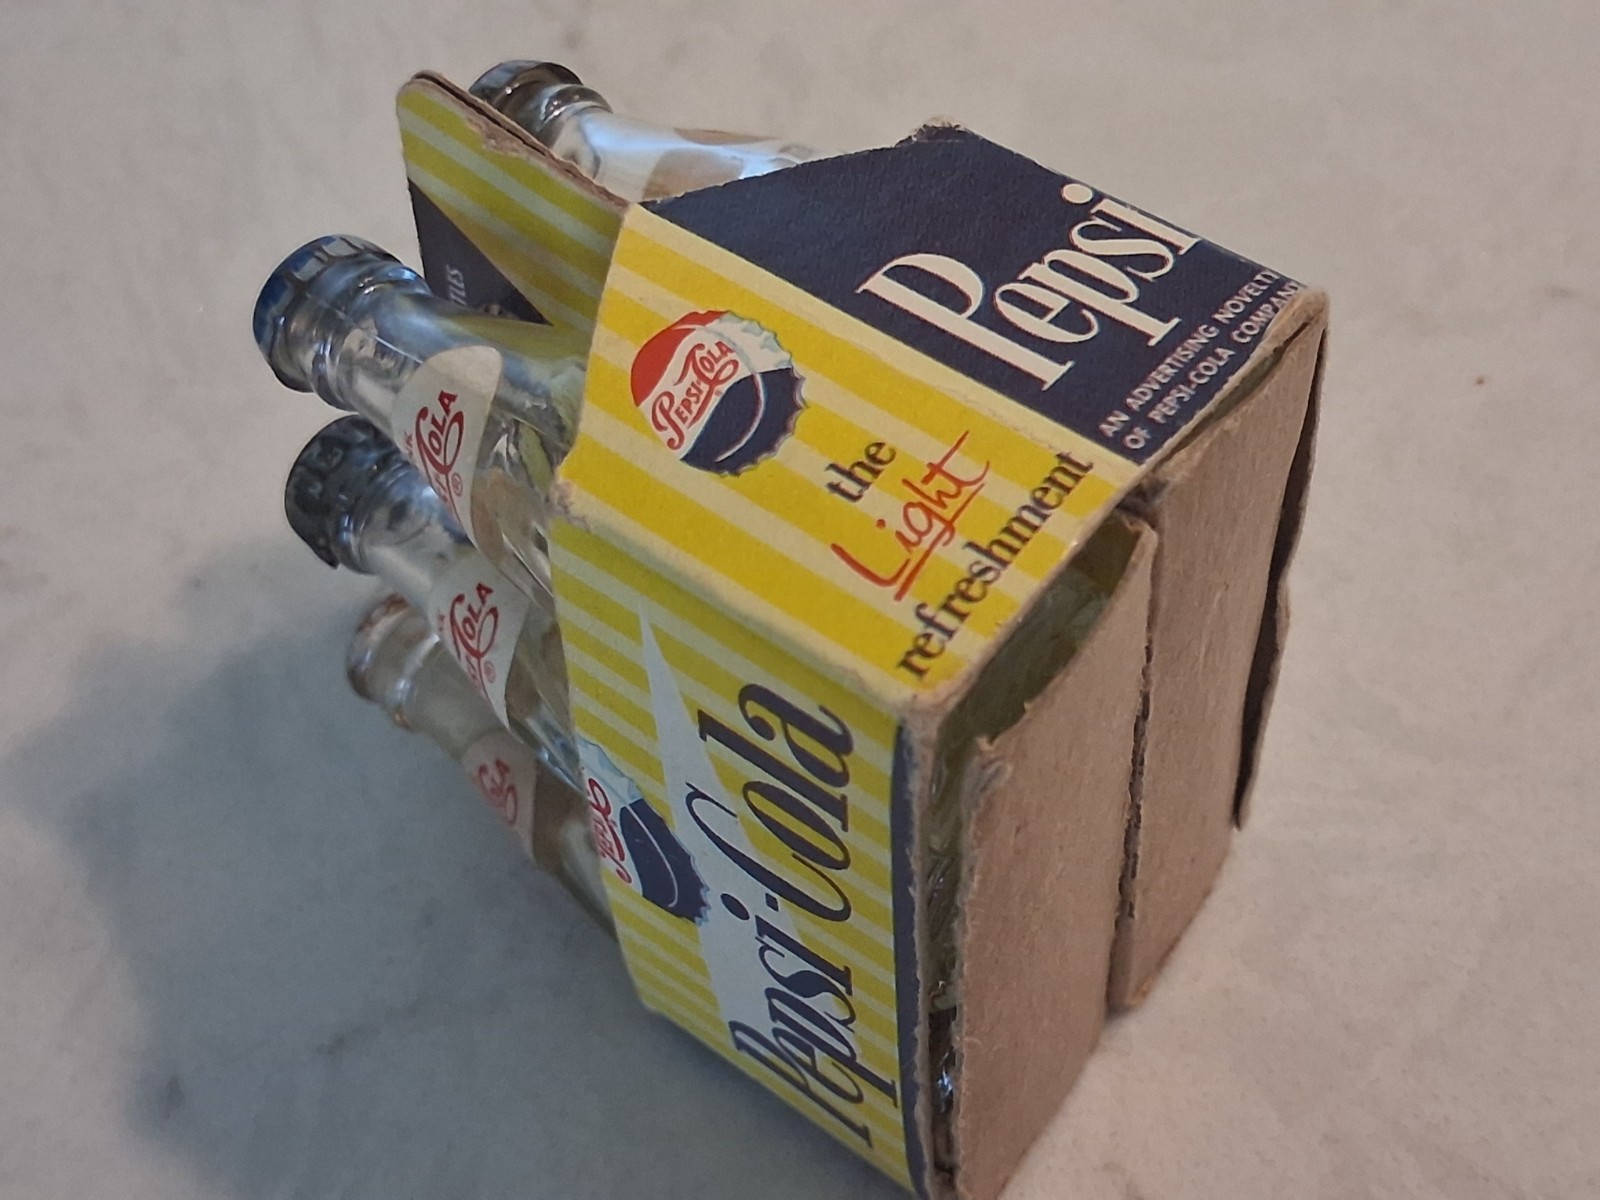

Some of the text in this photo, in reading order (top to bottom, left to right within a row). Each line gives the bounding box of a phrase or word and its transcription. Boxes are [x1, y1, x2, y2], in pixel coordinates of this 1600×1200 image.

[854, 183, 1201, 391] Pepsi
[1100, 410, 1130, 437] AN
[1126, 324, 1219, 411] ADVERTISING
[1123, 426, 1151, 449] OF
[1148, 347, 1236, 424] PEPSI-COLA
[826, 441, 896, 503] the
[830, 430, 990, 589] Light
[896, 452, 1094, 679] refreshment
[686, 683, 899, 1148] Pepsi-Cola
